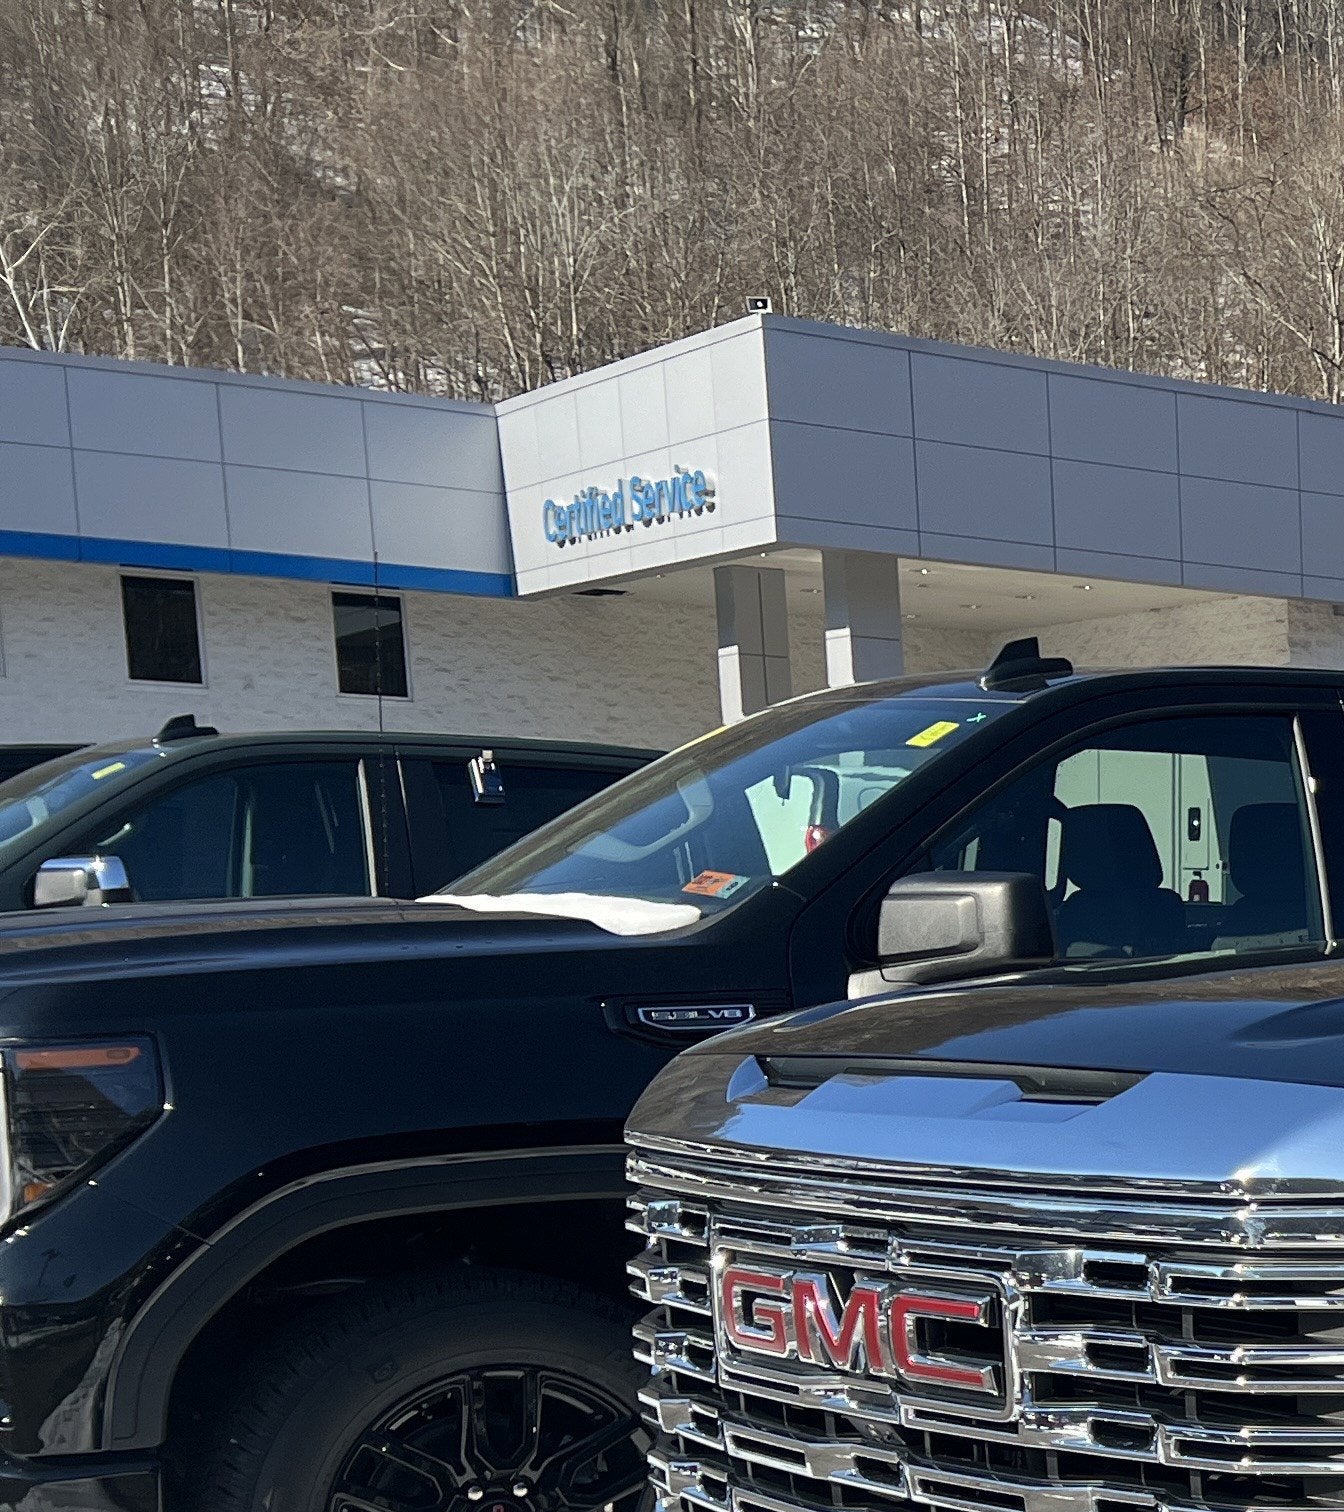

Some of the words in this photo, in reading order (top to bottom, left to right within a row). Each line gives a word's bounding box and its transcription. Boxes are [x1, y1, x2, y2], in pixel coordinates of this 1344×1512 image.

[543, 478, 625, 543] Certified
[630, 464, 706, 522] Service
[722, 1263, 999, 1396] GMC
